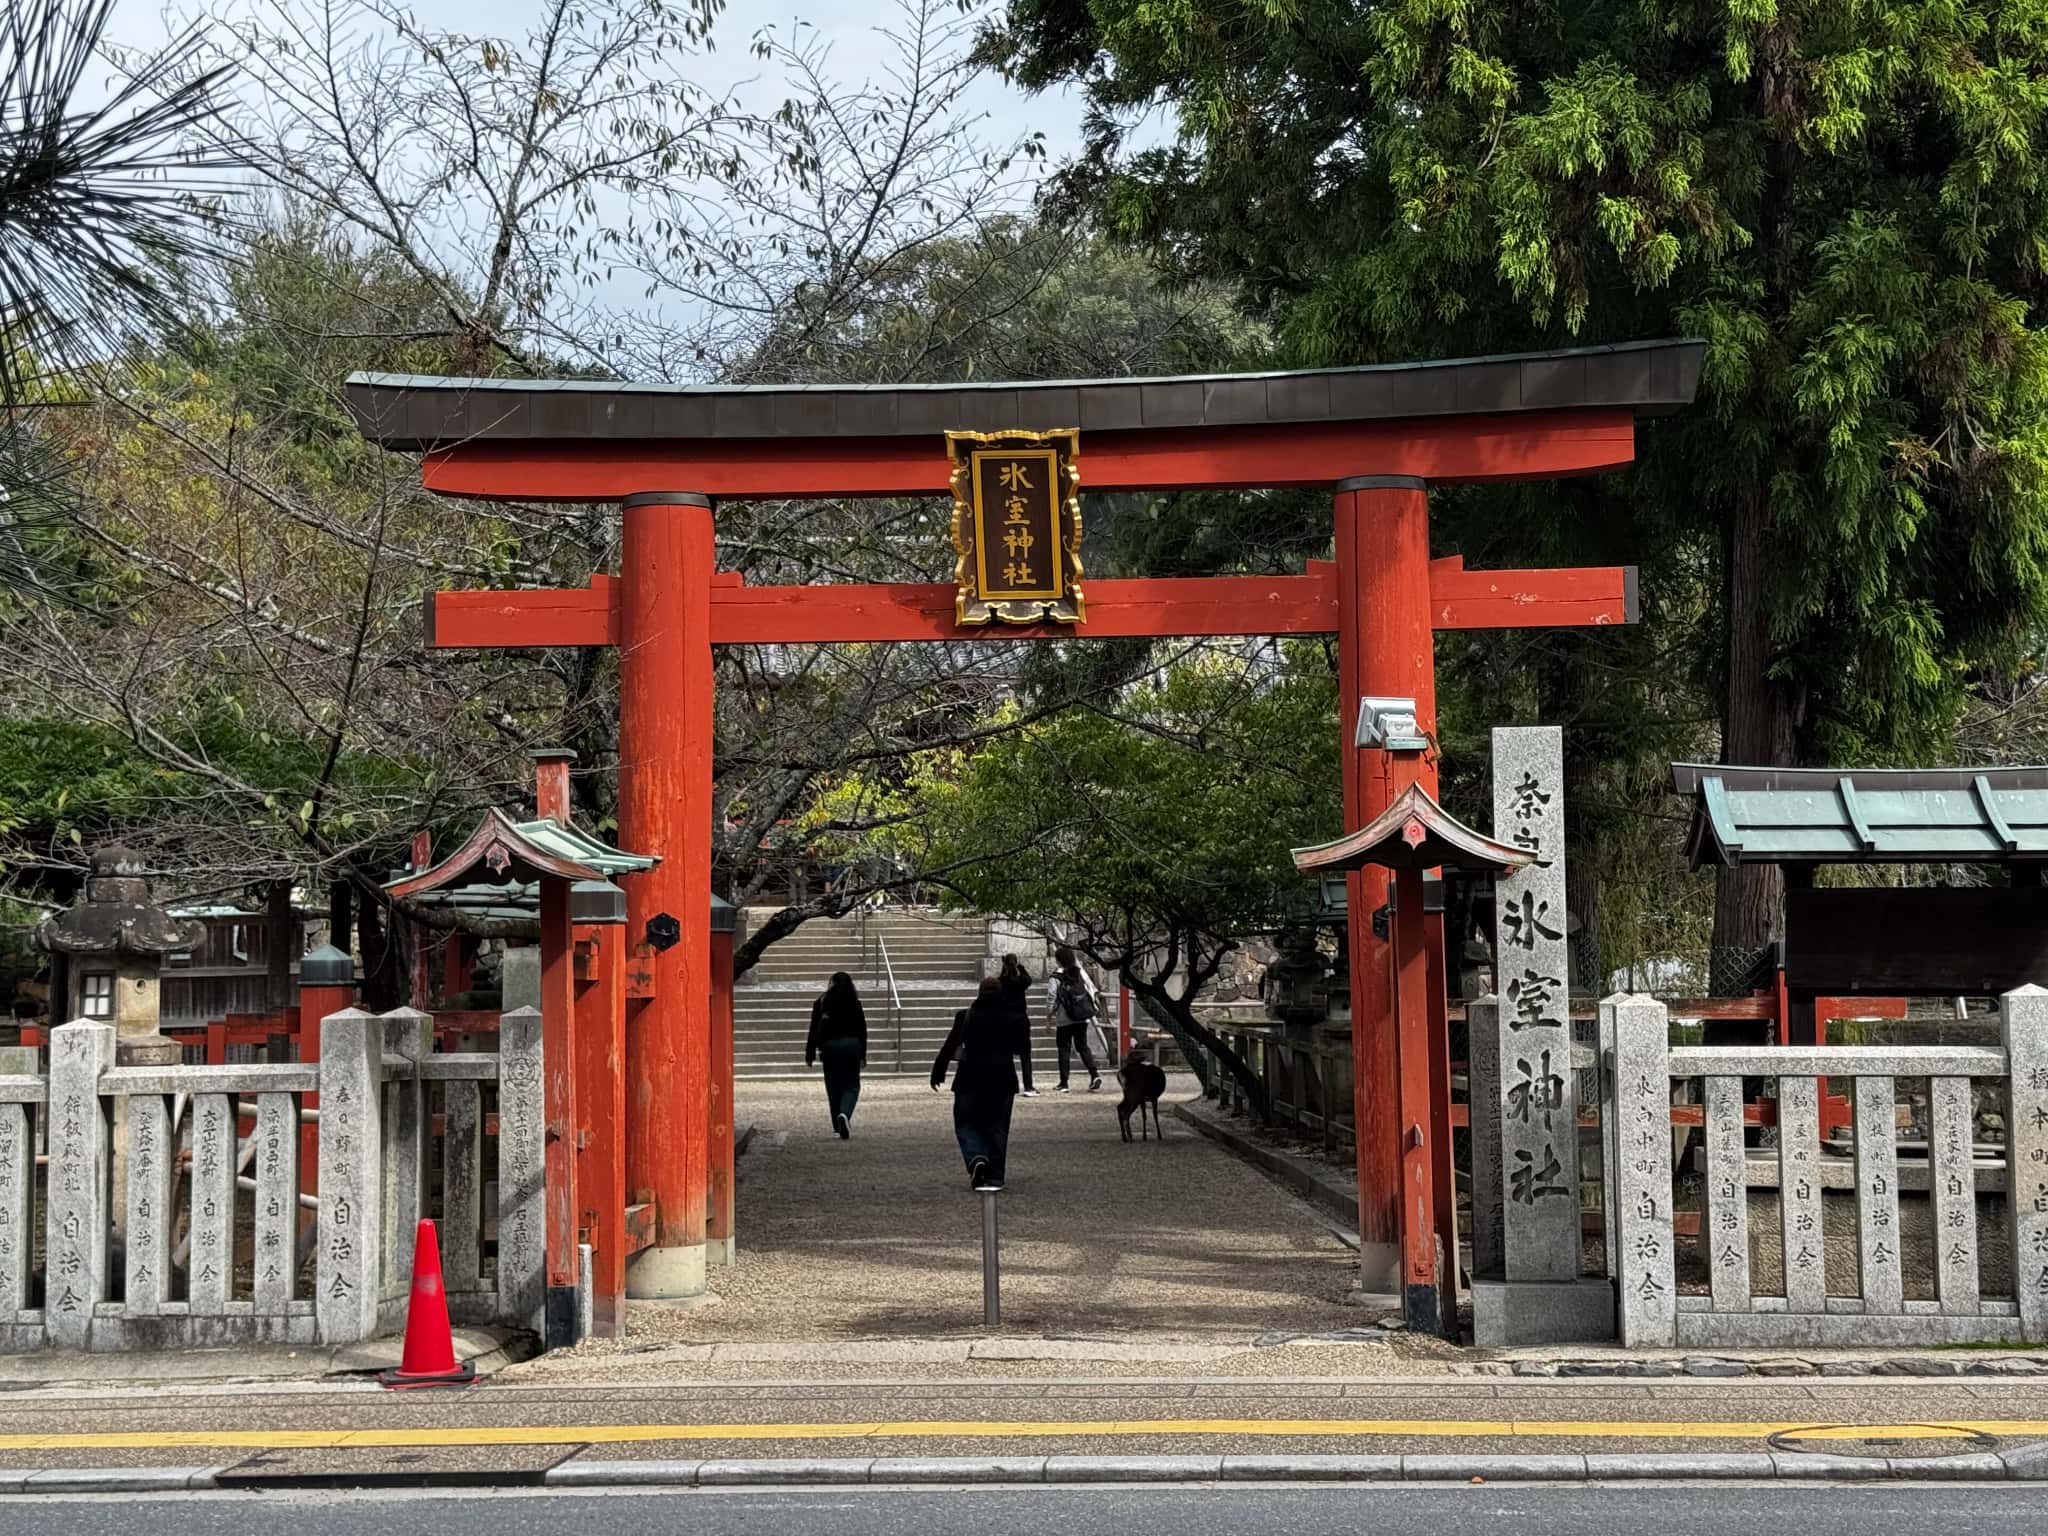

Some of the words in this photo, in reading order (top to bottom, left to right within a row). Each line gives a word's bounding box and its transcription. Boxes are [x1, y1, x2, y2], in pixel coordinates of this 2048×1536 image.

[999, 462, 1036, 586] 氷室神社
[328, 1086, 354, 1300] 春日野町自治会
